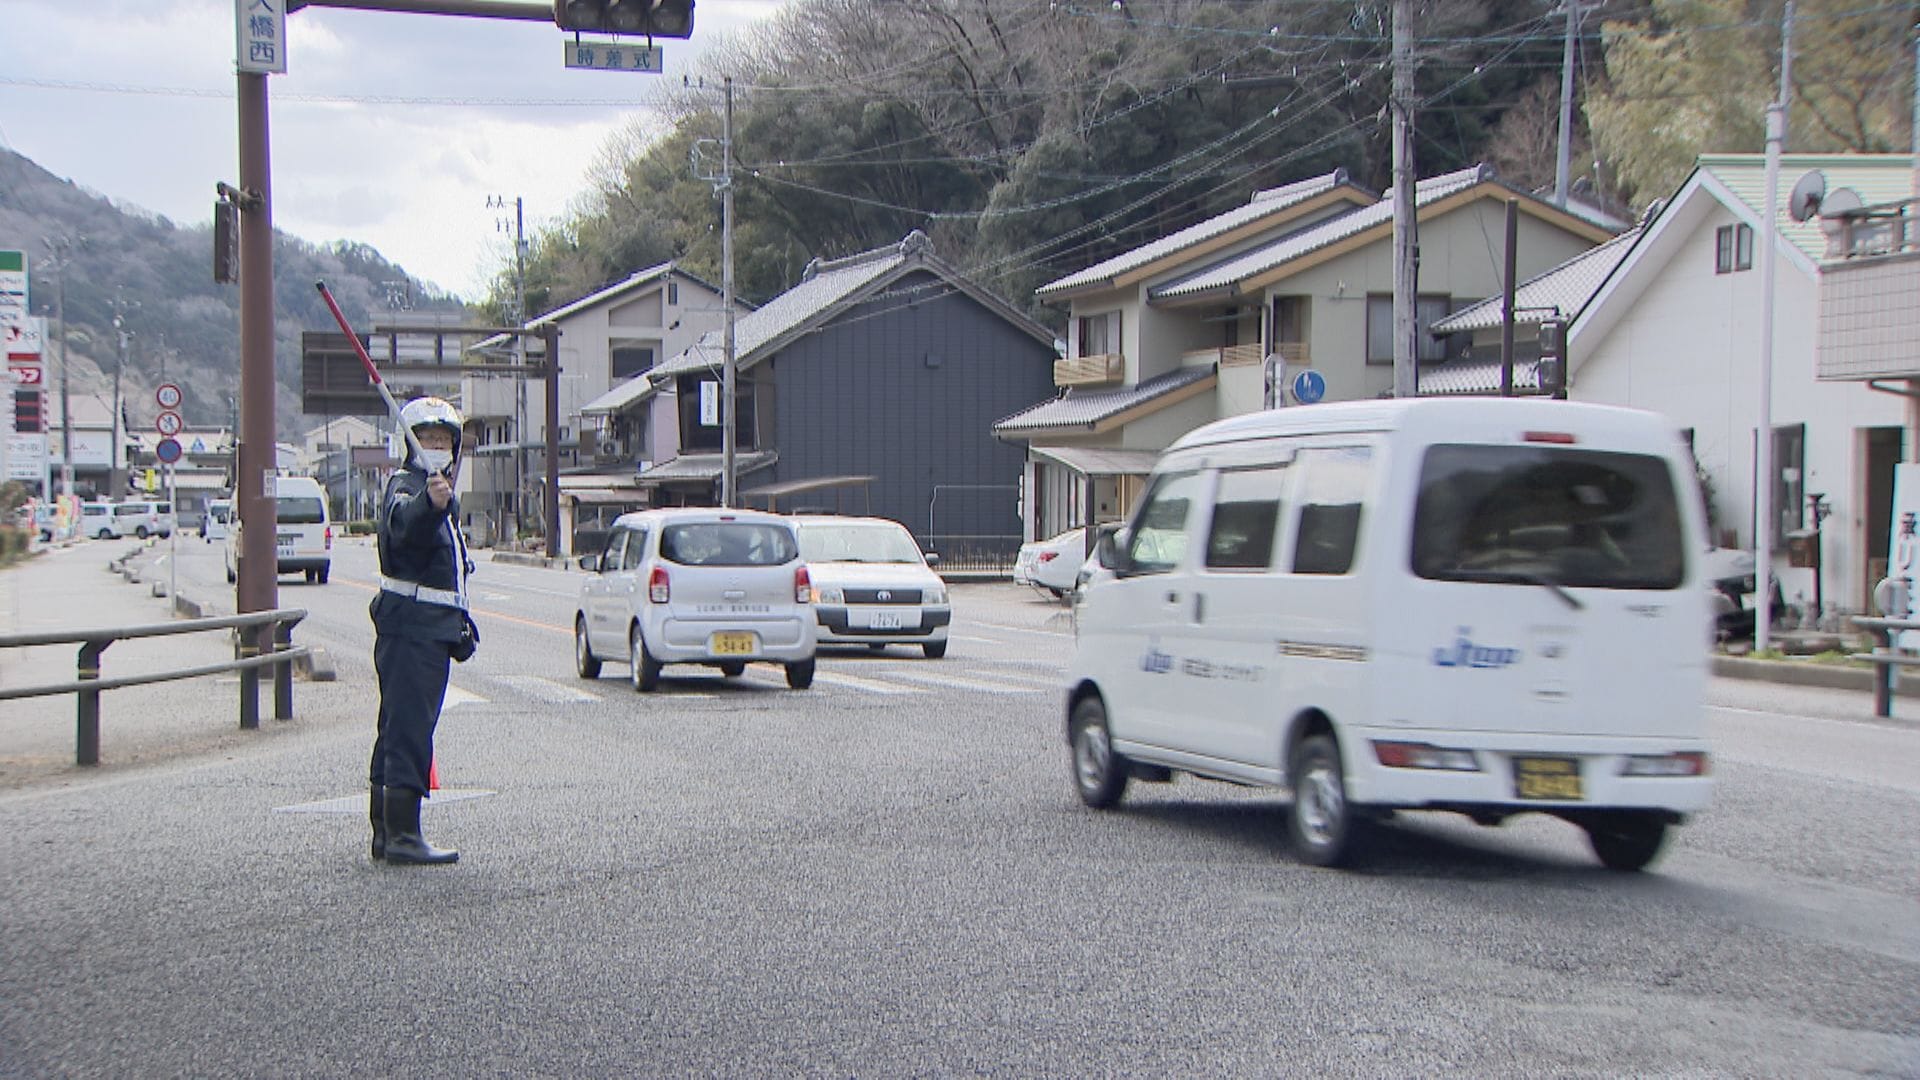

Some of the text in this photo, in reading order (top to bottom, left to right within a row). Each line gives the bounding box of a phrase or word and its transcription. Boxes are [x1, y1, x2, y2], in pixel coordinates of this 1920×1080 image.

[577, 47, 650, 69] 時差式
[162, 390, 176, 402] 40
